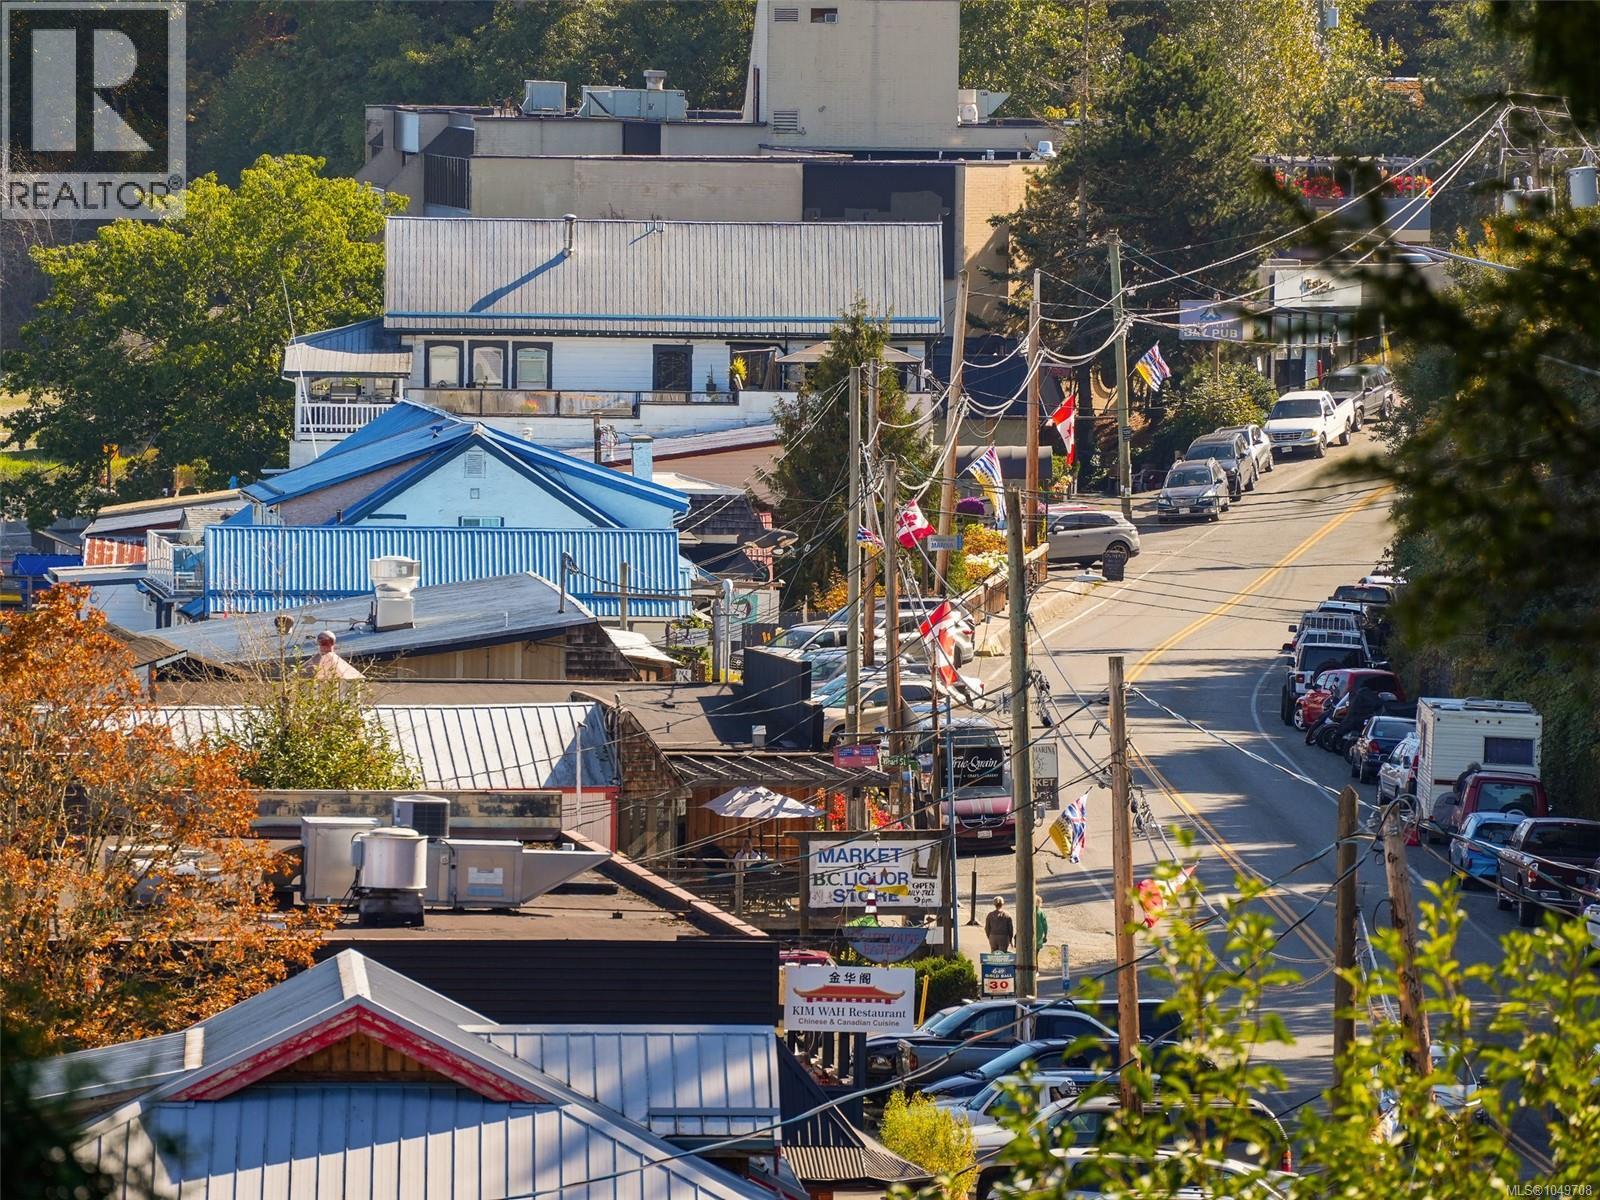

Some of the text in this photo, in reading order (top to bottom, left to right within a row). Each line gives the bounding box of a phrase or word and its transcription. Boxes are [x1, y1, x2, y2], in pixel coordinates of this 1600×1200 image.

[1211, 328, 1238, 338] PUB
[818, 847, 903, 864] MARKET
[828, 971, 872, 984] 金华阁
[989, 981, 1009, 990] 30
[792, 1005, 907, 1018] KIM WAH Restaurant
[798, 1017, 828, 1025] Chinese
[837, 1018, 871, 1027] Canadian
[872, 1019, 900, 1027] Cuisine
